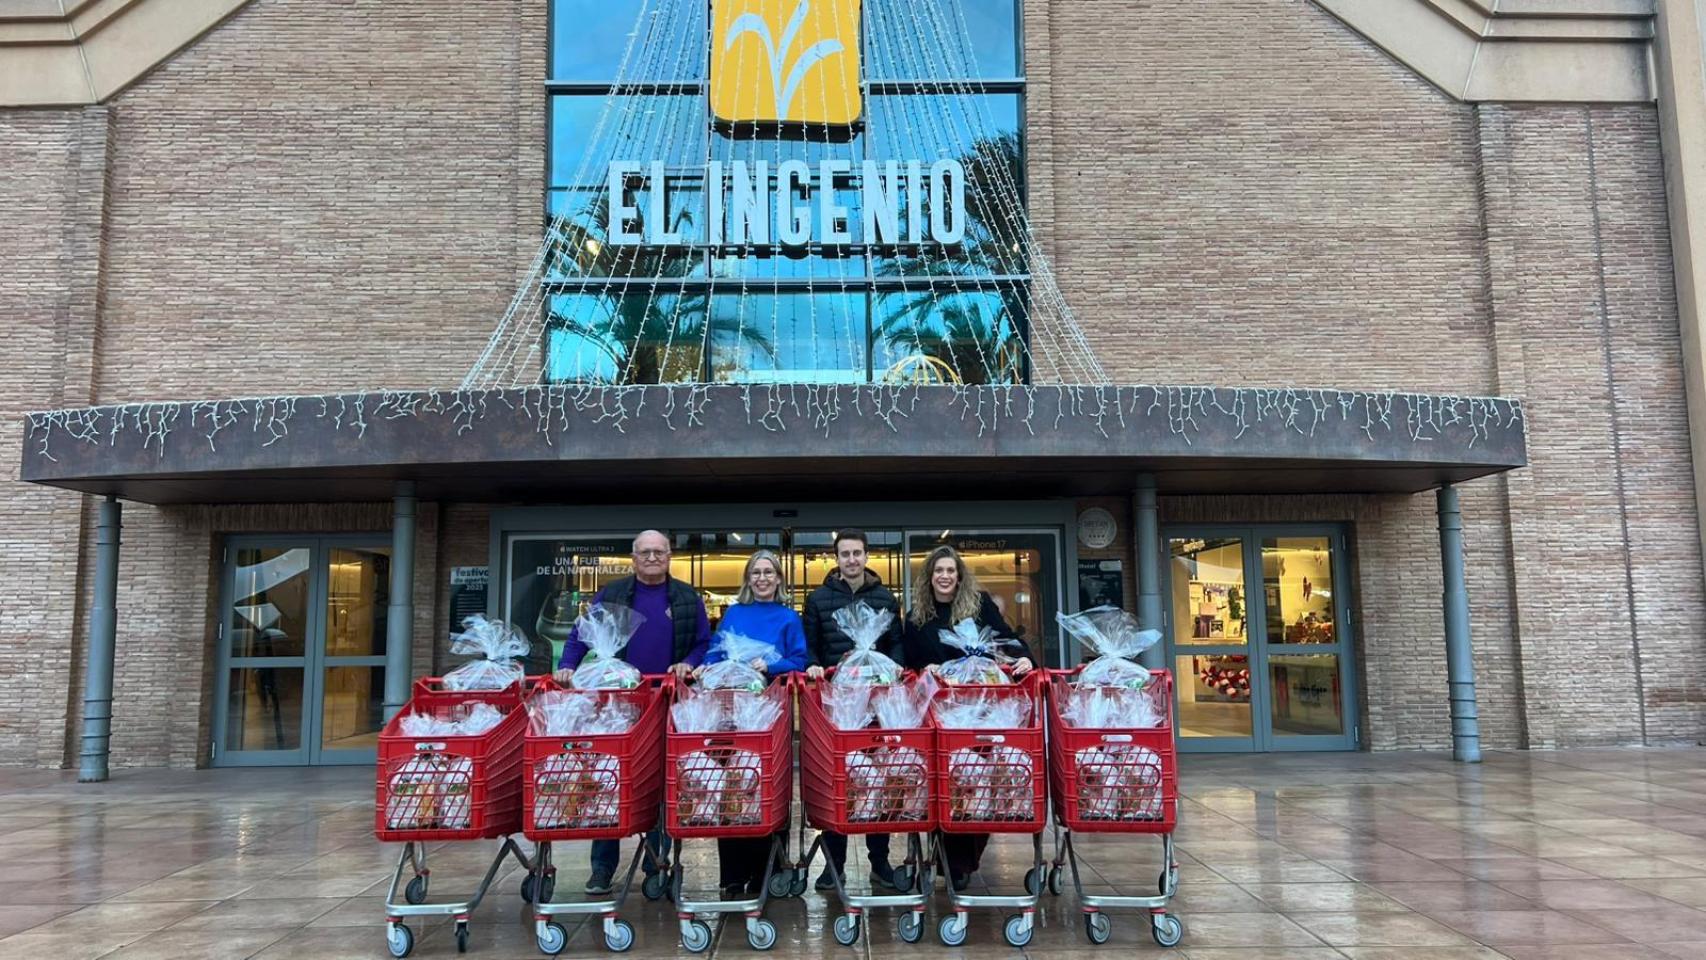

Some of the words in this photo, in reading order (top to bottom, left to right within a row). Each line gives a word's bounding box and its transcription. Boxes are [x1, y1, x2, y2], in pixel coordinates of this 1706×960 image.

[608, 160, 681, 245] EL
[709, 159, 966, 246] INGENIO
[555, 556, 578, 566] UNA
[536, 566, 551, 575] DE
[552, 566, 566, 575] LA
[567, 565, 635, 575] NATURALEZA
